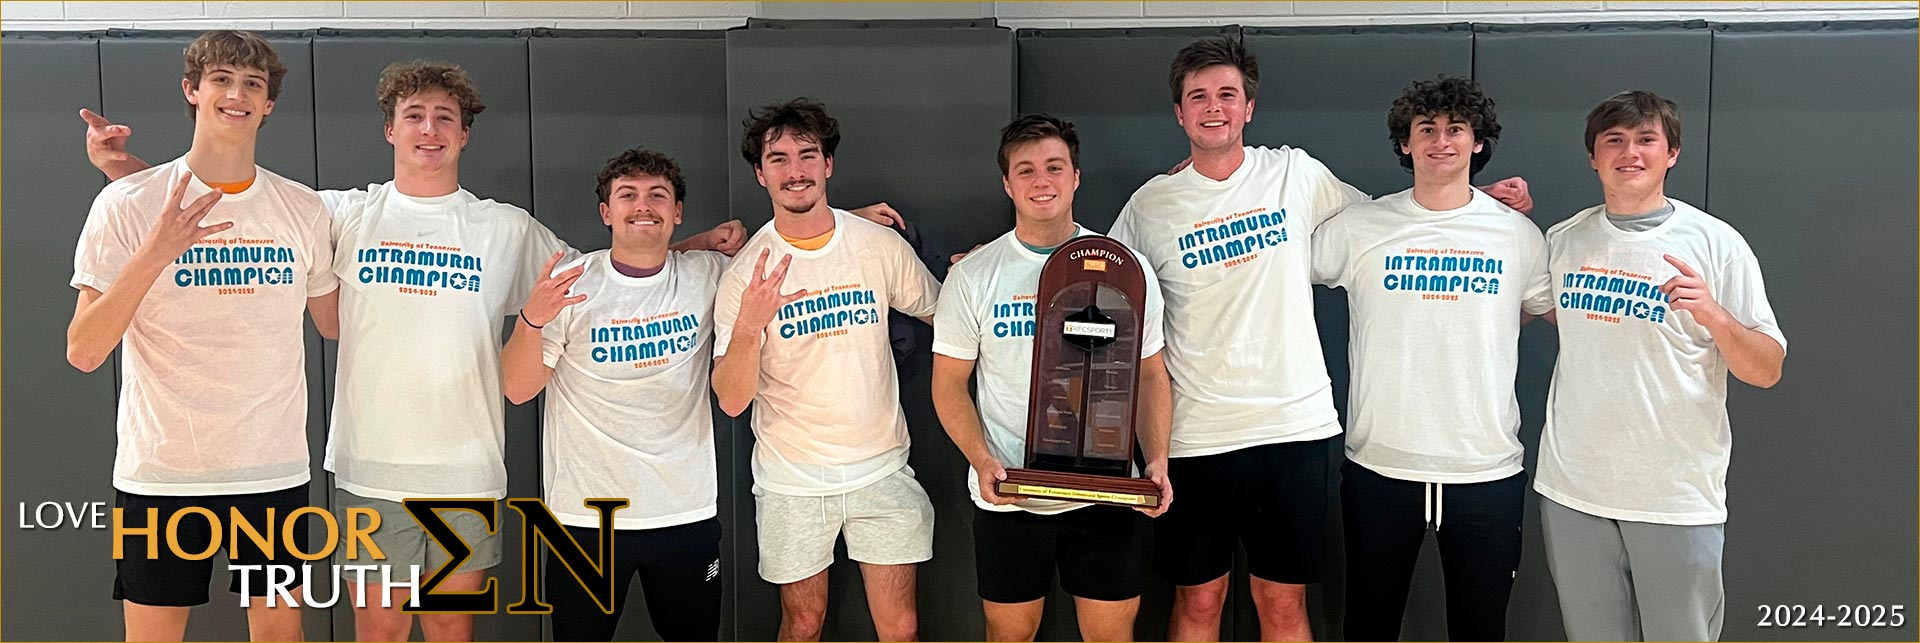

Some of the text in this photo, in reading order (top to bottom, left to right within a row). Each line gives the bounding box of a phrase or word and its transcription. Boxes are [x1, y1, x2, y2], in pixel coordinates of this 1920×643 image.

[195, 237, 227, 246] niversity
[380, 241, 414, 249] University
[425, 243, 462, 252] Tennessee
[358, 248, 482, 272] INTRAMURAL
[1070, 249, 1124, 265] CHAMPION
[1449, 248, 1485, 256] Tennessee
[1385, 256, 1503, 275] INTRAMURAL
[174, 267, 293, 287] CHAMPION
[358, 266, 480, 292] CHAMPION
[1383, 274, 1499, 294] CHAMPION
[399, 287, 437, 296] 2024-2025
[1560, 292, 1665, 323] CHAMPION
[780, 308, 879, 339] CHAMPION
[1586, 313, 1621, 323] 2024-2025
[591, 314, 699, 343] INTRAMURAL
[591, 332, 697, 363] CHAMPION
